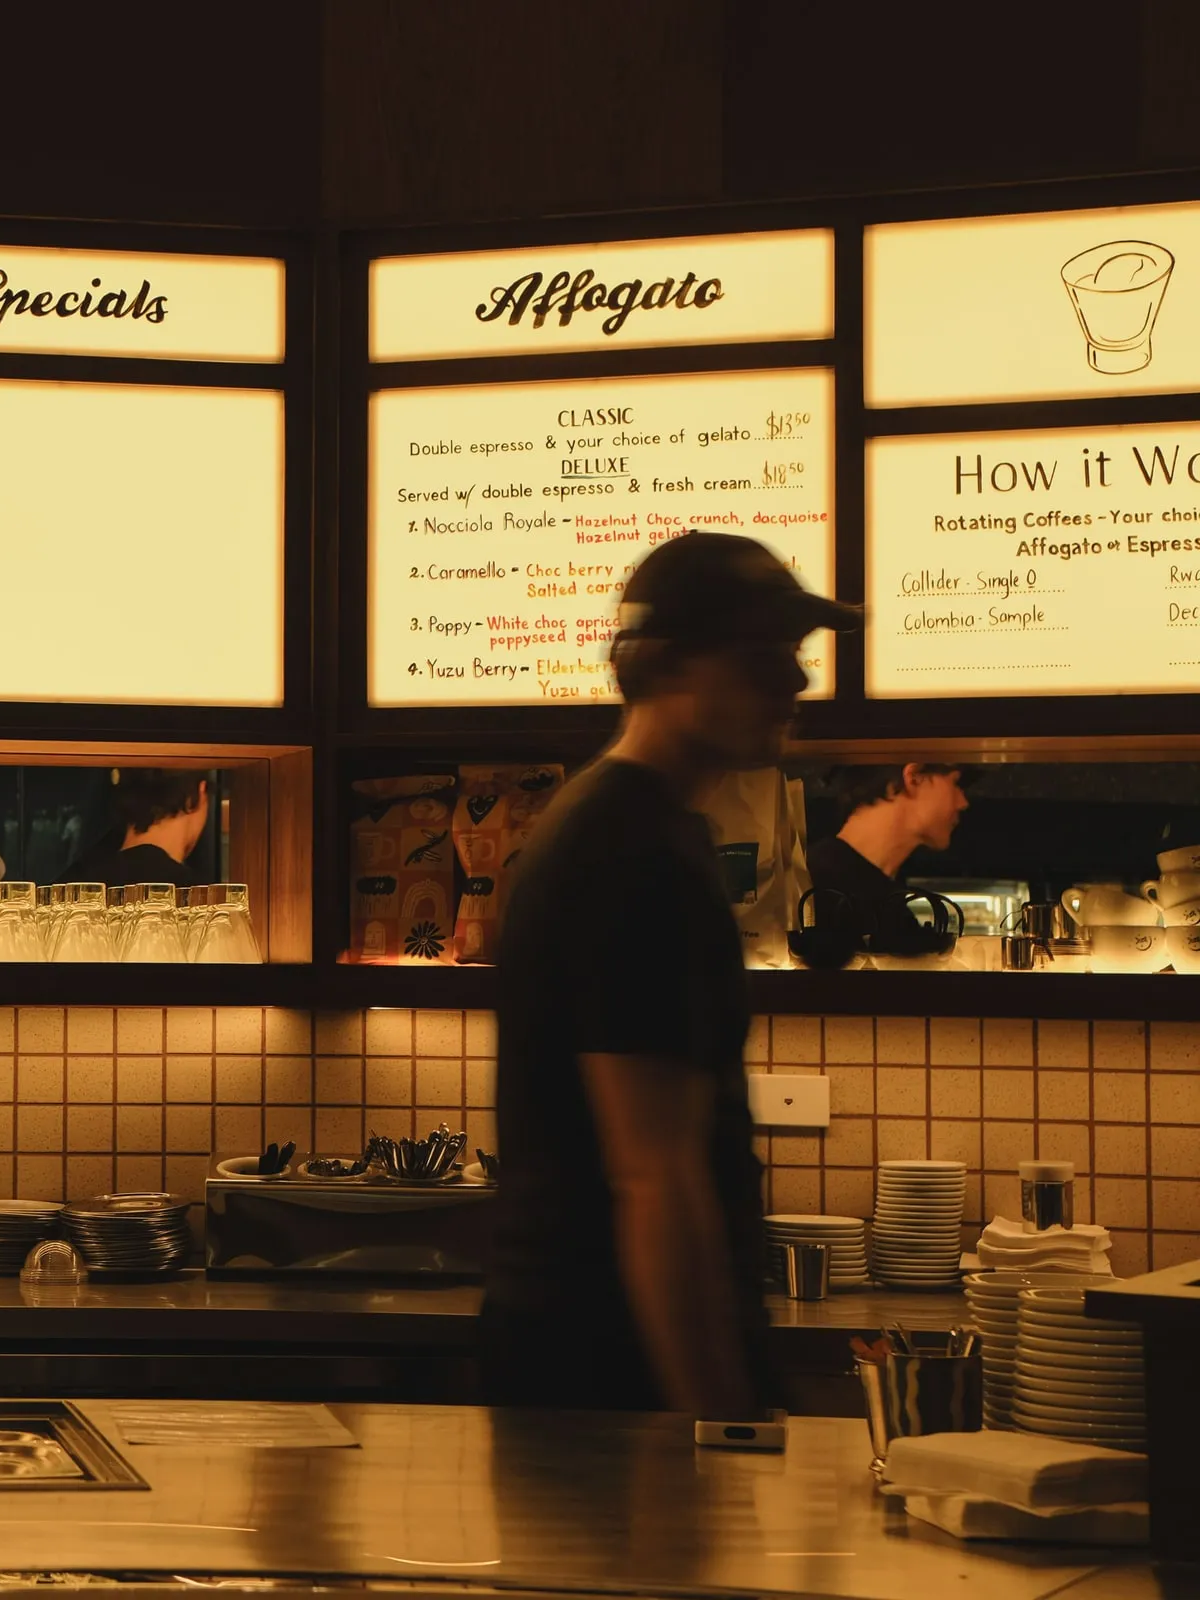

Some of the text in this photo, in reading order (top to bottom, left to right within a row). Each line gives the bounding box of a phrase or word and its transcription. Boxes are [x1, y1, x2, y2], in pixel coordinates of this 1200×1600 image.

[475, 268, 725, 336] Affogato
[557, 407, 634, 428] CLASSIC
[409, 440, 462, 456] Double
[470, 441, 534, 457] espresso
[546, 435, 557, 449] &
[567, 437, 604, 454] your
[612, 432, 661, 447] choice
[670, 428, 685, 444] of
[698, 425, 751, 447] gelato
[561, 456, 630, 475] DELUXE
[956, 454, 1057, 495] How
[1083, 448, 1112, 488] it
[398, 487, 449, 503] Served
[455, 484, 476, 508] w/
[482, 483, 533, 499] double
[542, 483, 615, 502] espresso
[628, 478, 641, 493] &
[653, 476, 694, 493] fresh
[703, 478, 751, 491] cream
[424, 513, 493, 535] Nocciola
[503, 510, 557, 532] Royale
[575, 513, 637, 528] Hazelnut
[646, 513, 682, 525] Choc
[689, 511, 745, 526] crunch,
[752, 510, 828, 527] dacquoise
[934, 514, 1017, 534] Rotating
[1023, 510, 1092, 528] Coffees
[1162, 507, 1200, 522] choi
[576, 526, 688, 546] Hazelnut gelat
[1016, 536, 1200, 560] Affogato or Espress
[409, 567, 425, 579] 2.
[428, 561, 506, 580] Caramello
[526, 563, 561, 578] Choc
[568, 561, 614, 578] berry
[527, 581, 625, 598] Salted cara
[902, 568, 961, 594] Collider
[977, 570, 1019, 600] Single
[410, 617, 423, 631] 3.
[487, 614, 529, 631] White
[534, 614, 567, 629] choc
[576, 615, 621, 632] aprico
[988, 604, 1045, 629] Sample
[1169, 603, 1200, 622] Dec
[490, 629, 612, 651] poppyseed gelat
[407, 662, 423, 676] 4.
[426, 659, 465, 679] Yuzu
[537, 680, 622, 701] Yuzu gela
